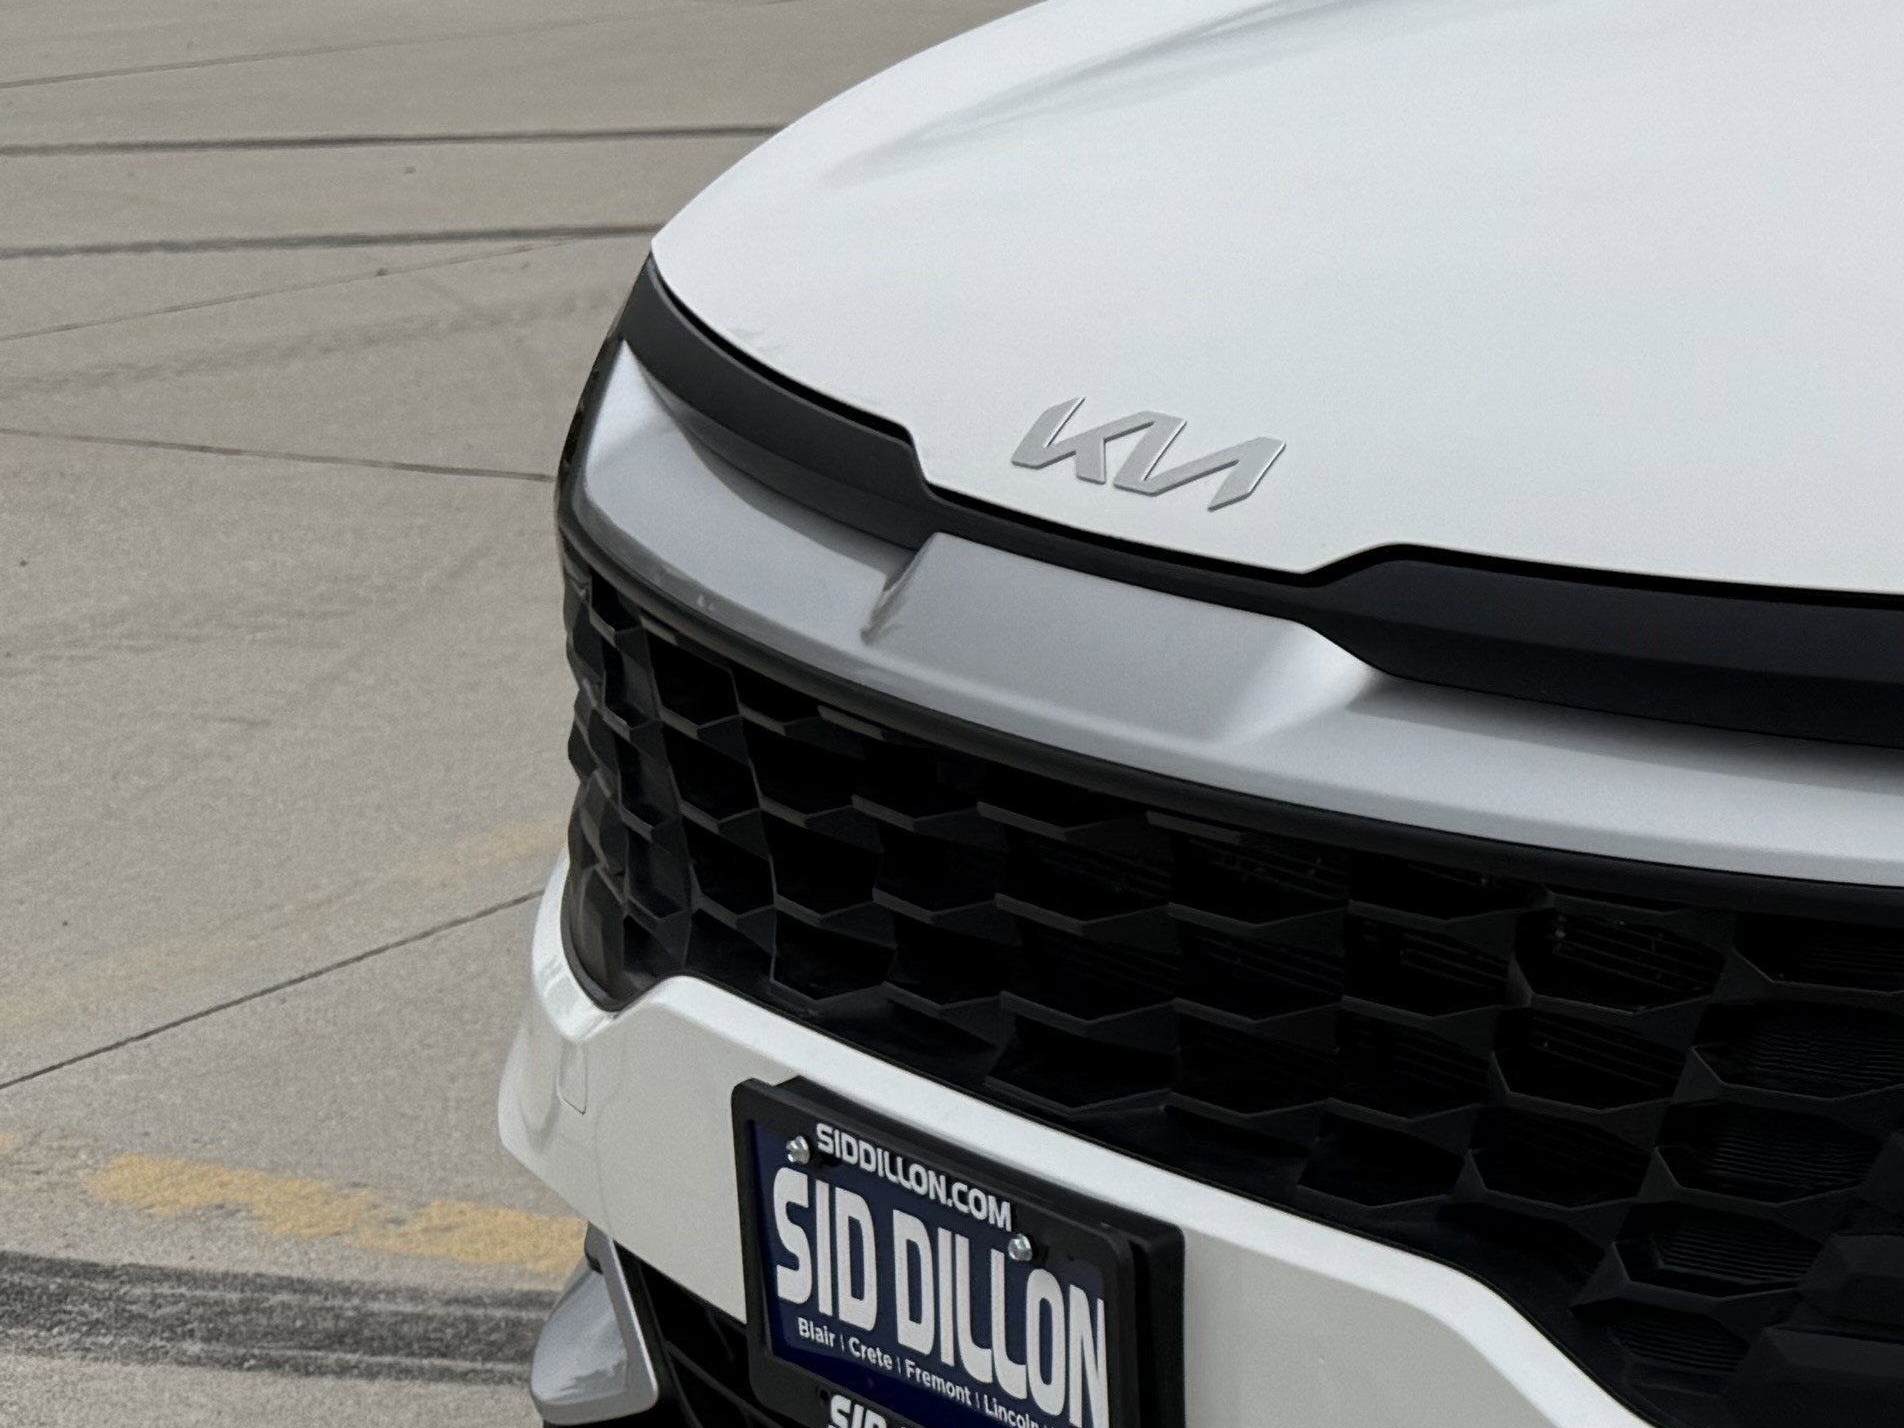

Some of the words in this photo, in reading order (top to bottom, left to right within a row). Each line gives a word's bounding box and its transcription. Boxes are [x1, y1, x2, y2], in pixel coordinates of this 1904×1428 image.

[1011, 396, 1286, 512] KIA
[815, 1122, 1012, 1233] SIDDILLON.COM
[773, 1166, 878, 1332] SID
[797, 1316, 835, 1348] Blair
[848, 1336, 893, 1371] Crete
[904, 1358, 972, 1406] Fremont
